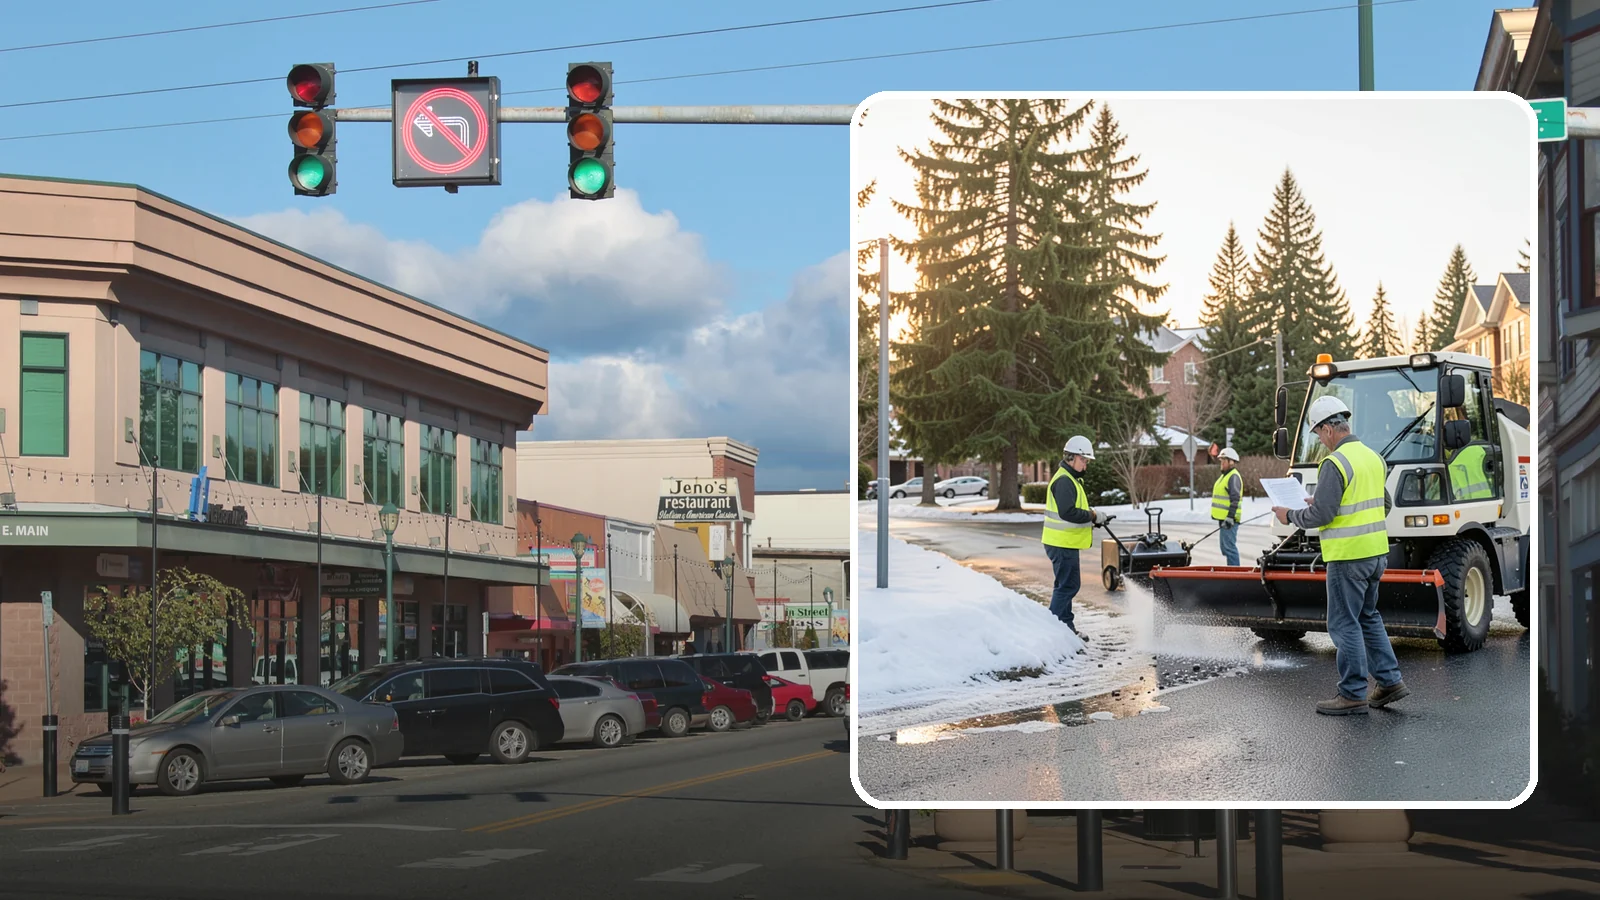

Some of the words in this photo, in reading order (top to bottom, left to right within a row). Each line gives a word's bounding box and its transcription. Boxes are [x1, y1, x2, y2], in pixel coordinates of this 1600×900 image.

[670, 480, 727, 494] Jeno's
[665, 496, 730, 508] restaurant
[659, 510, 681, 520] Italian
[686, 509, 714, 519] American
[715, 509, 737, 519] Cuisine
[2, 525, 13, 536] E.
[15, 525, 48, 536] MAIN
[797, 608, 828, 616] Street
